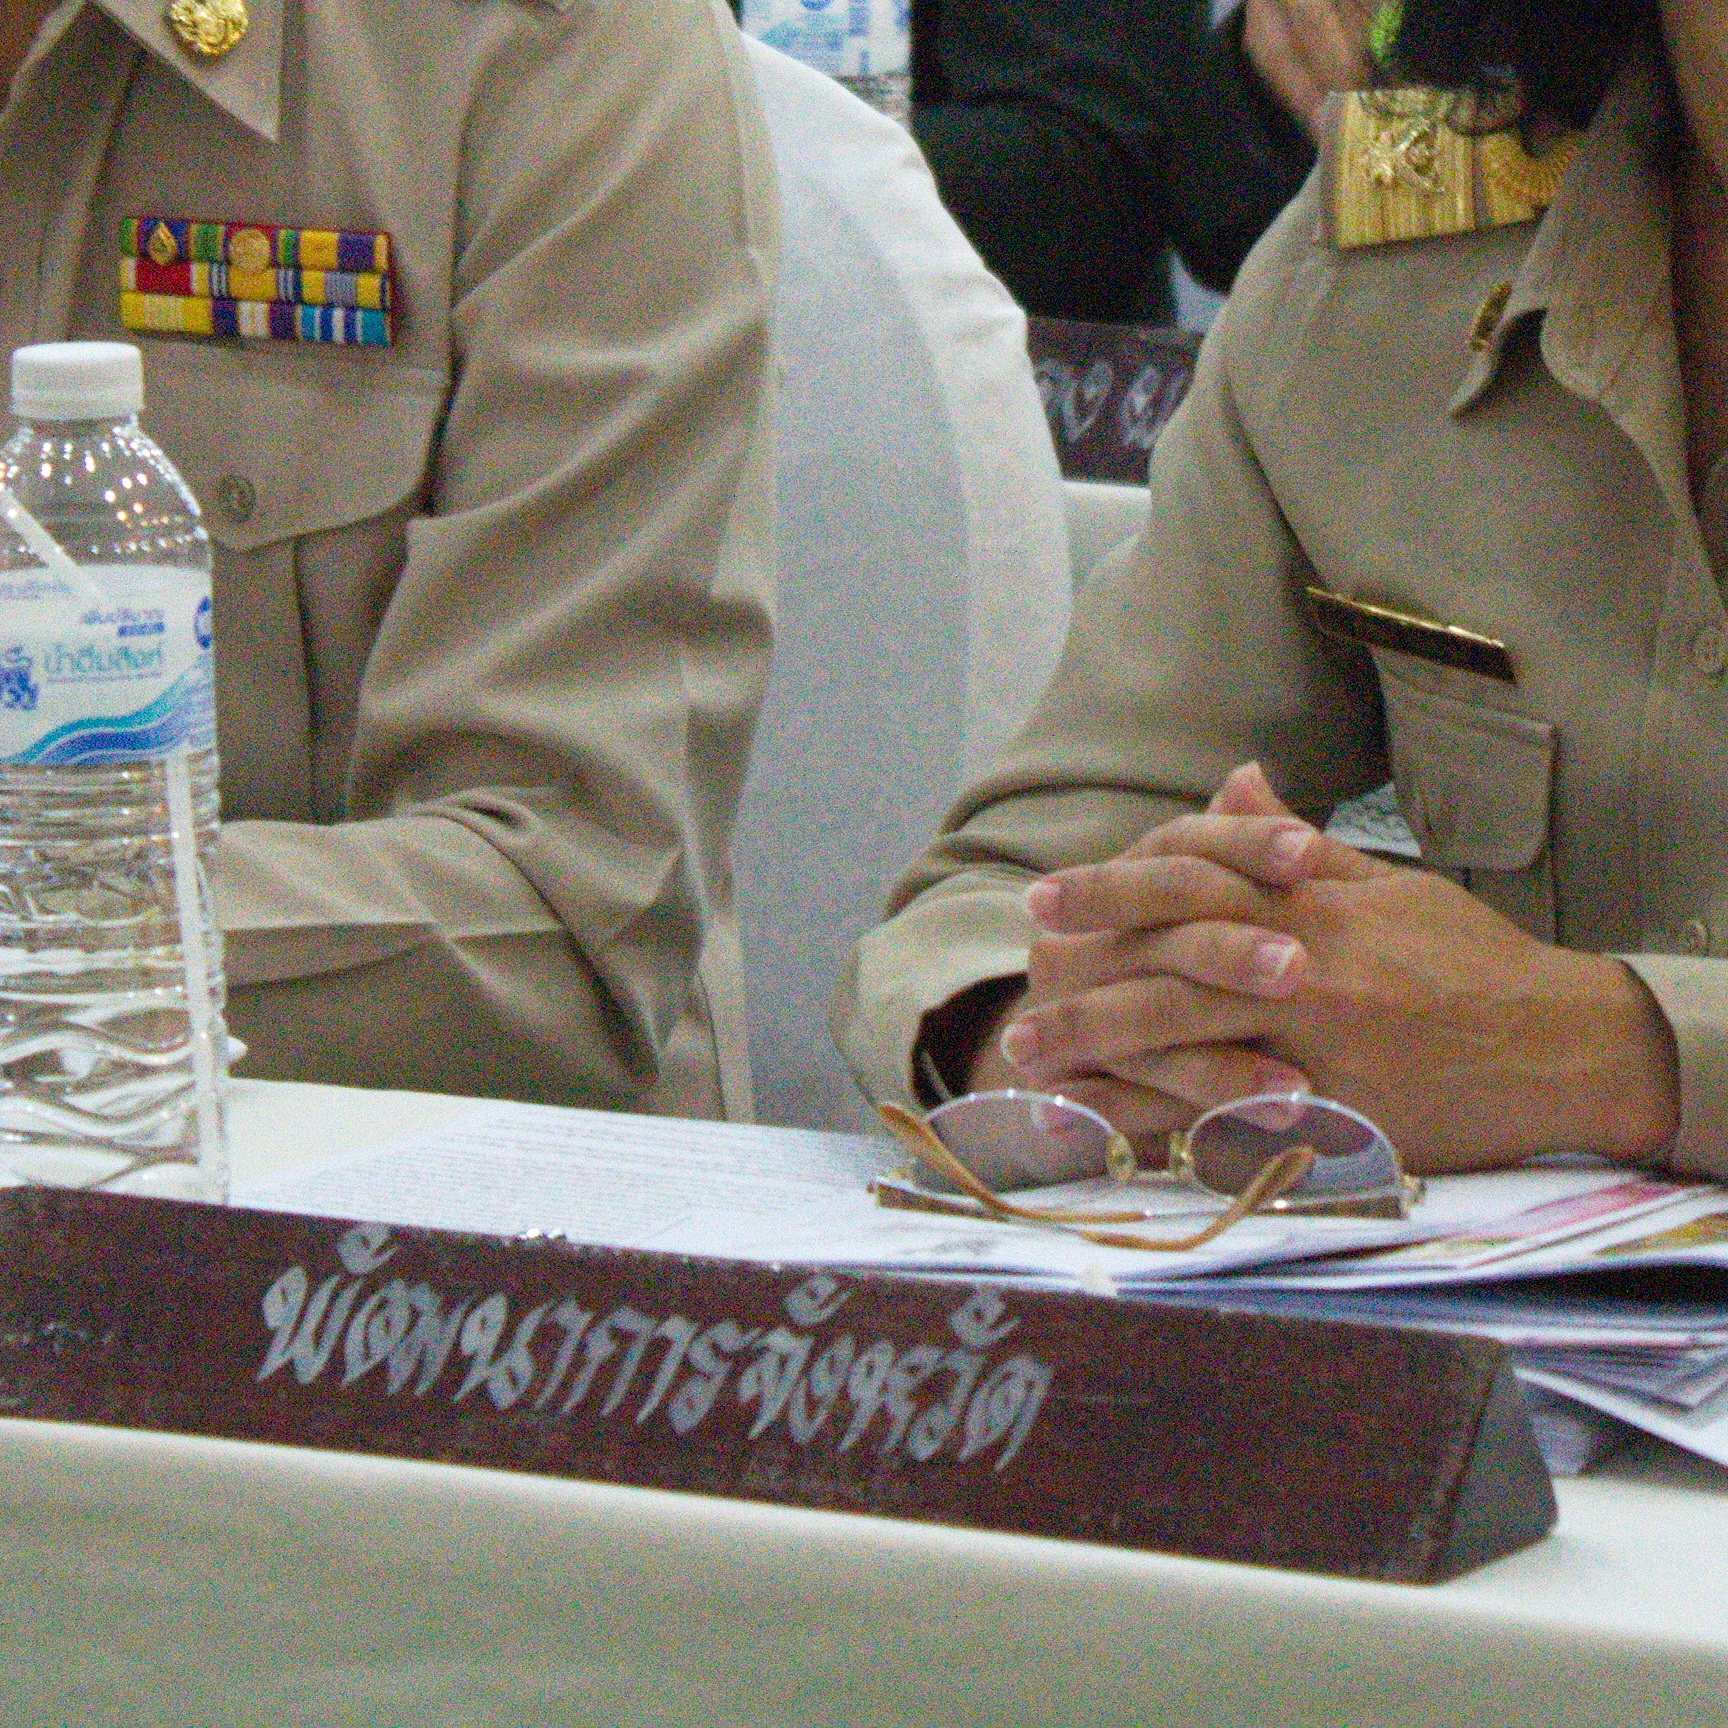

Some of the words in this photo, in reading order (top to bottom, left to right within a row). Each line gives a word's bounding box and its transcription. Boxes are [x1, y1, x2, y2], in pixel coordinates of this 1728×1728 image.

[256, 1222, 1054, 1473] พัฒนาการจังหวัด
